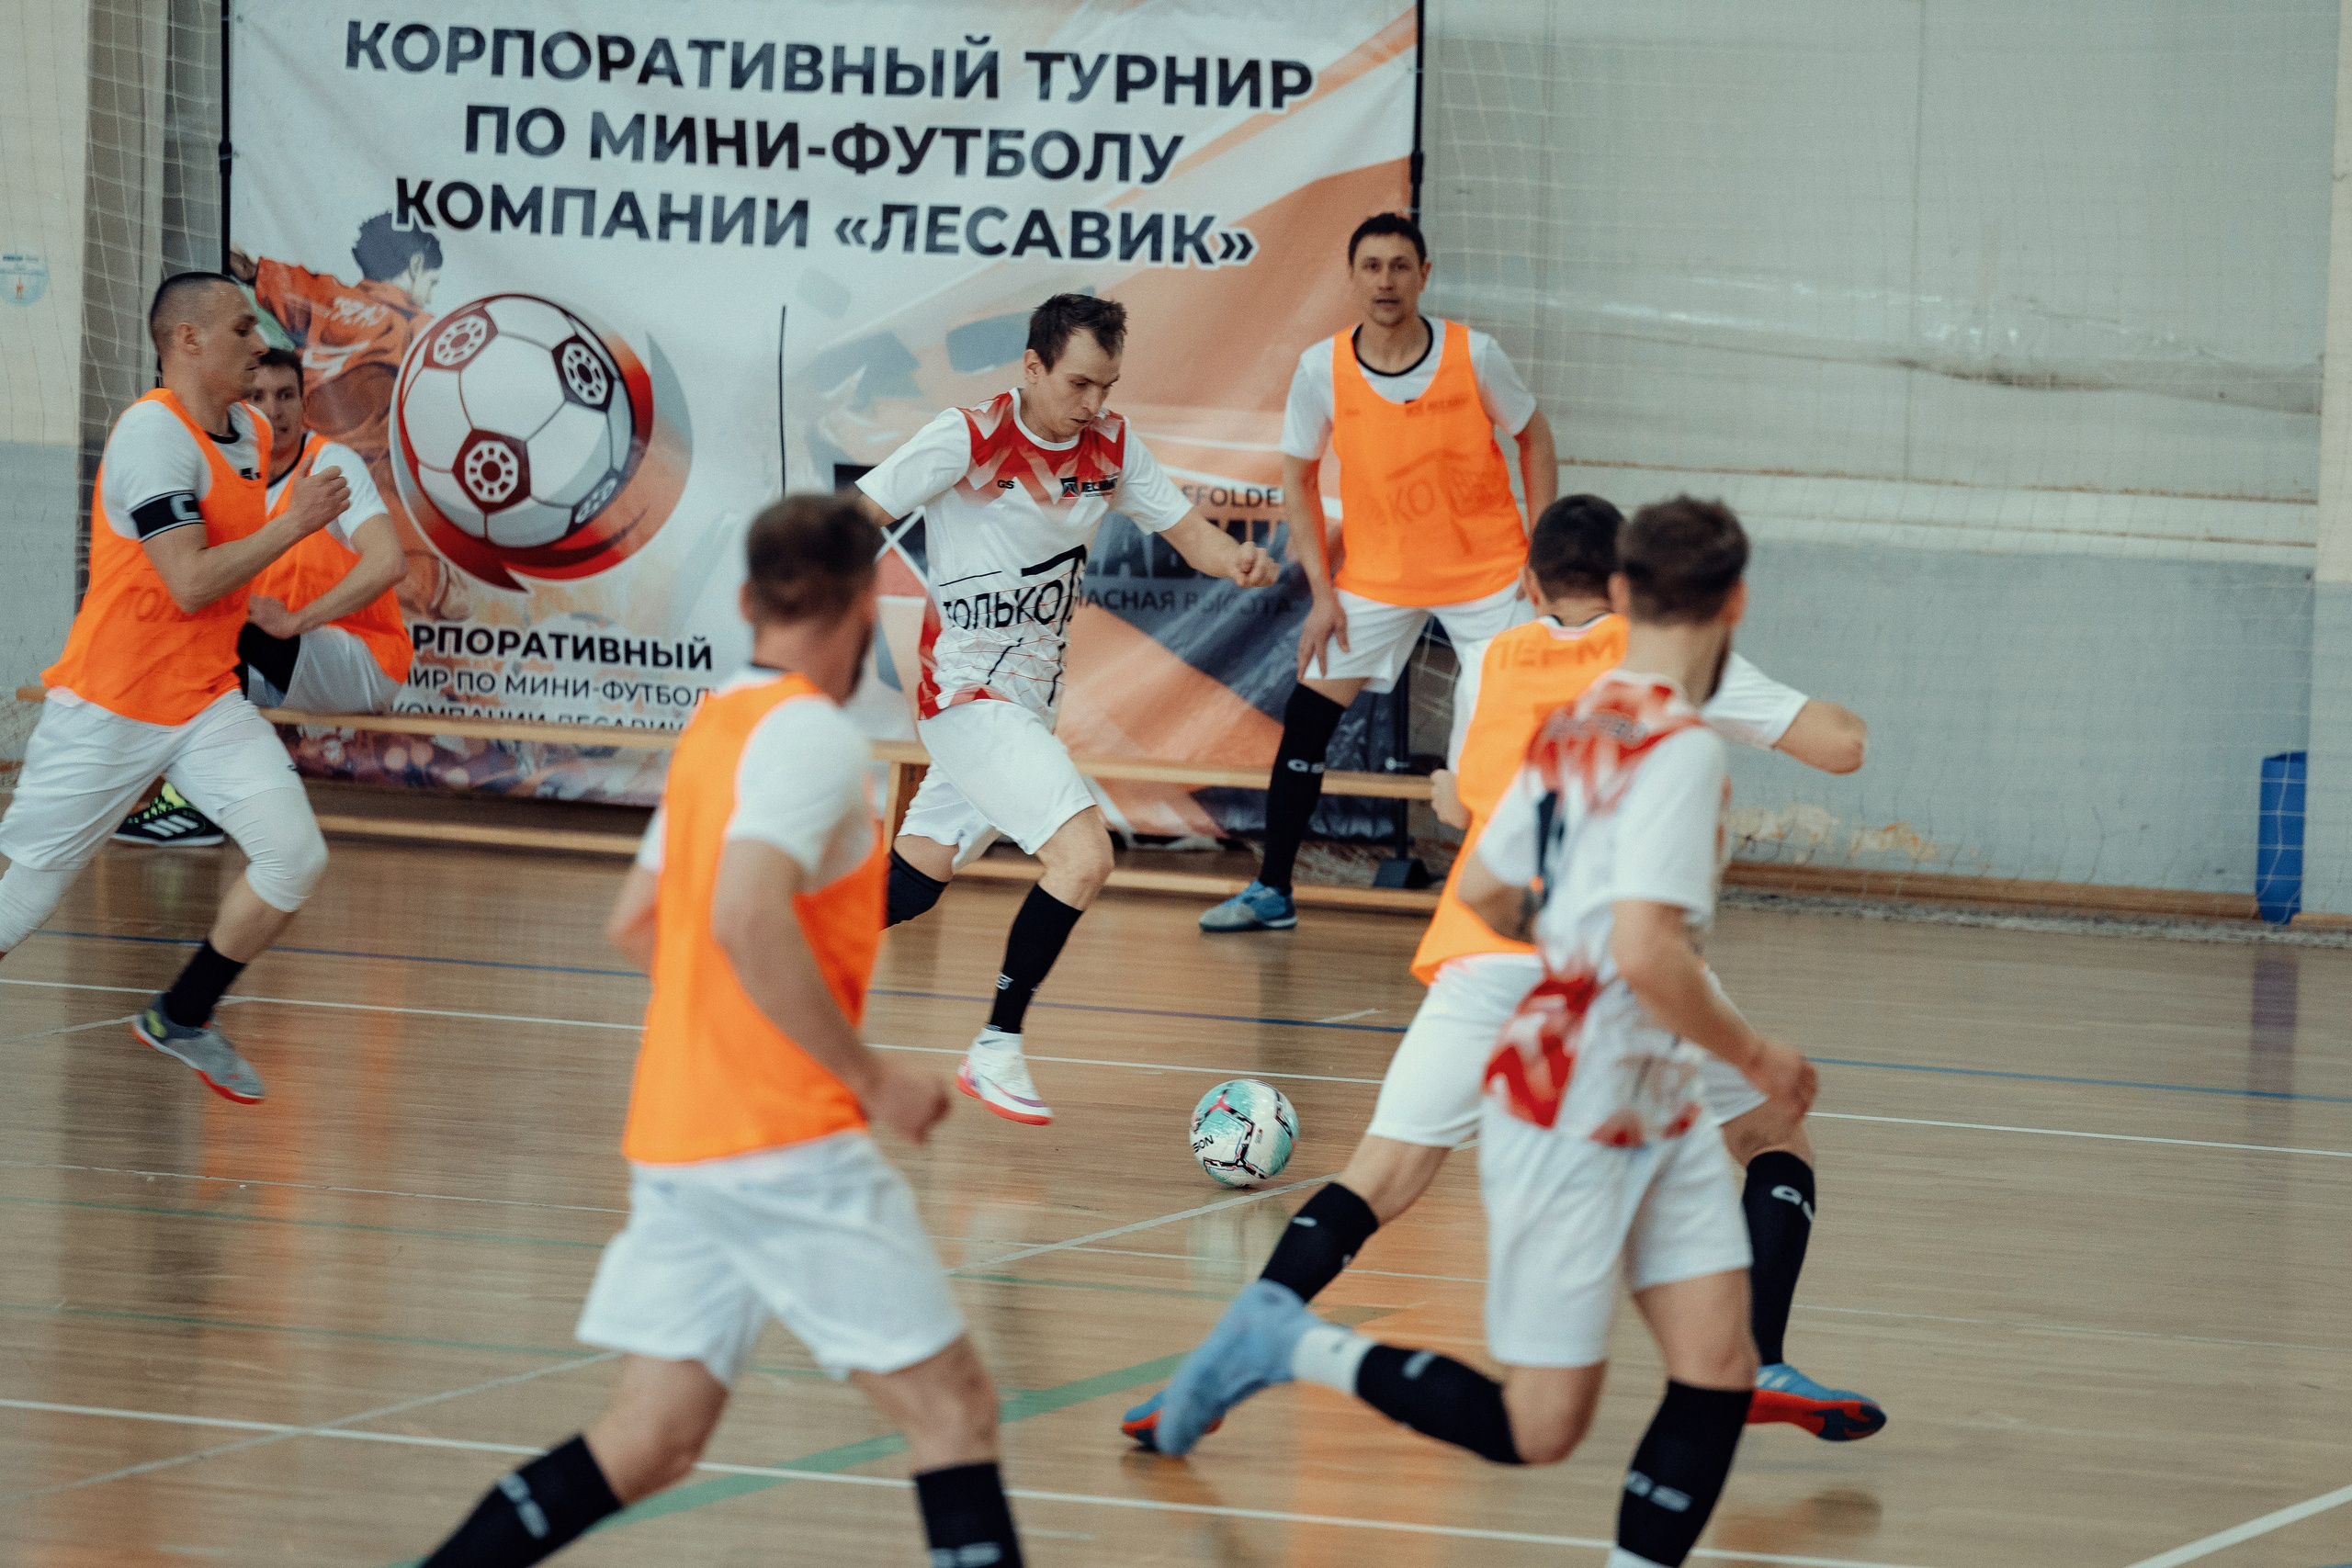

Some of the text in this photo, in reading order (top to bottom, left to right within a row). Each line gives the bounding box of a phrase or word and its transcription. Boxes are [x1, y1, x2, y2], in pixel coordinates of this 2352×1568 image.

[346, 20, 1313, 108] КОРПОРАТИВНЫЙ ТУРНИР
[465, 105, 1183, 184] ПО МИНИ-ФУТБОЛУ
[395, 177, 1255, 265] КОМПАНИИ «ЛЕСАВИК»
[1080, 588, 1177, 612] АСНАЯ
[458, 671, 496, 694] ПО
